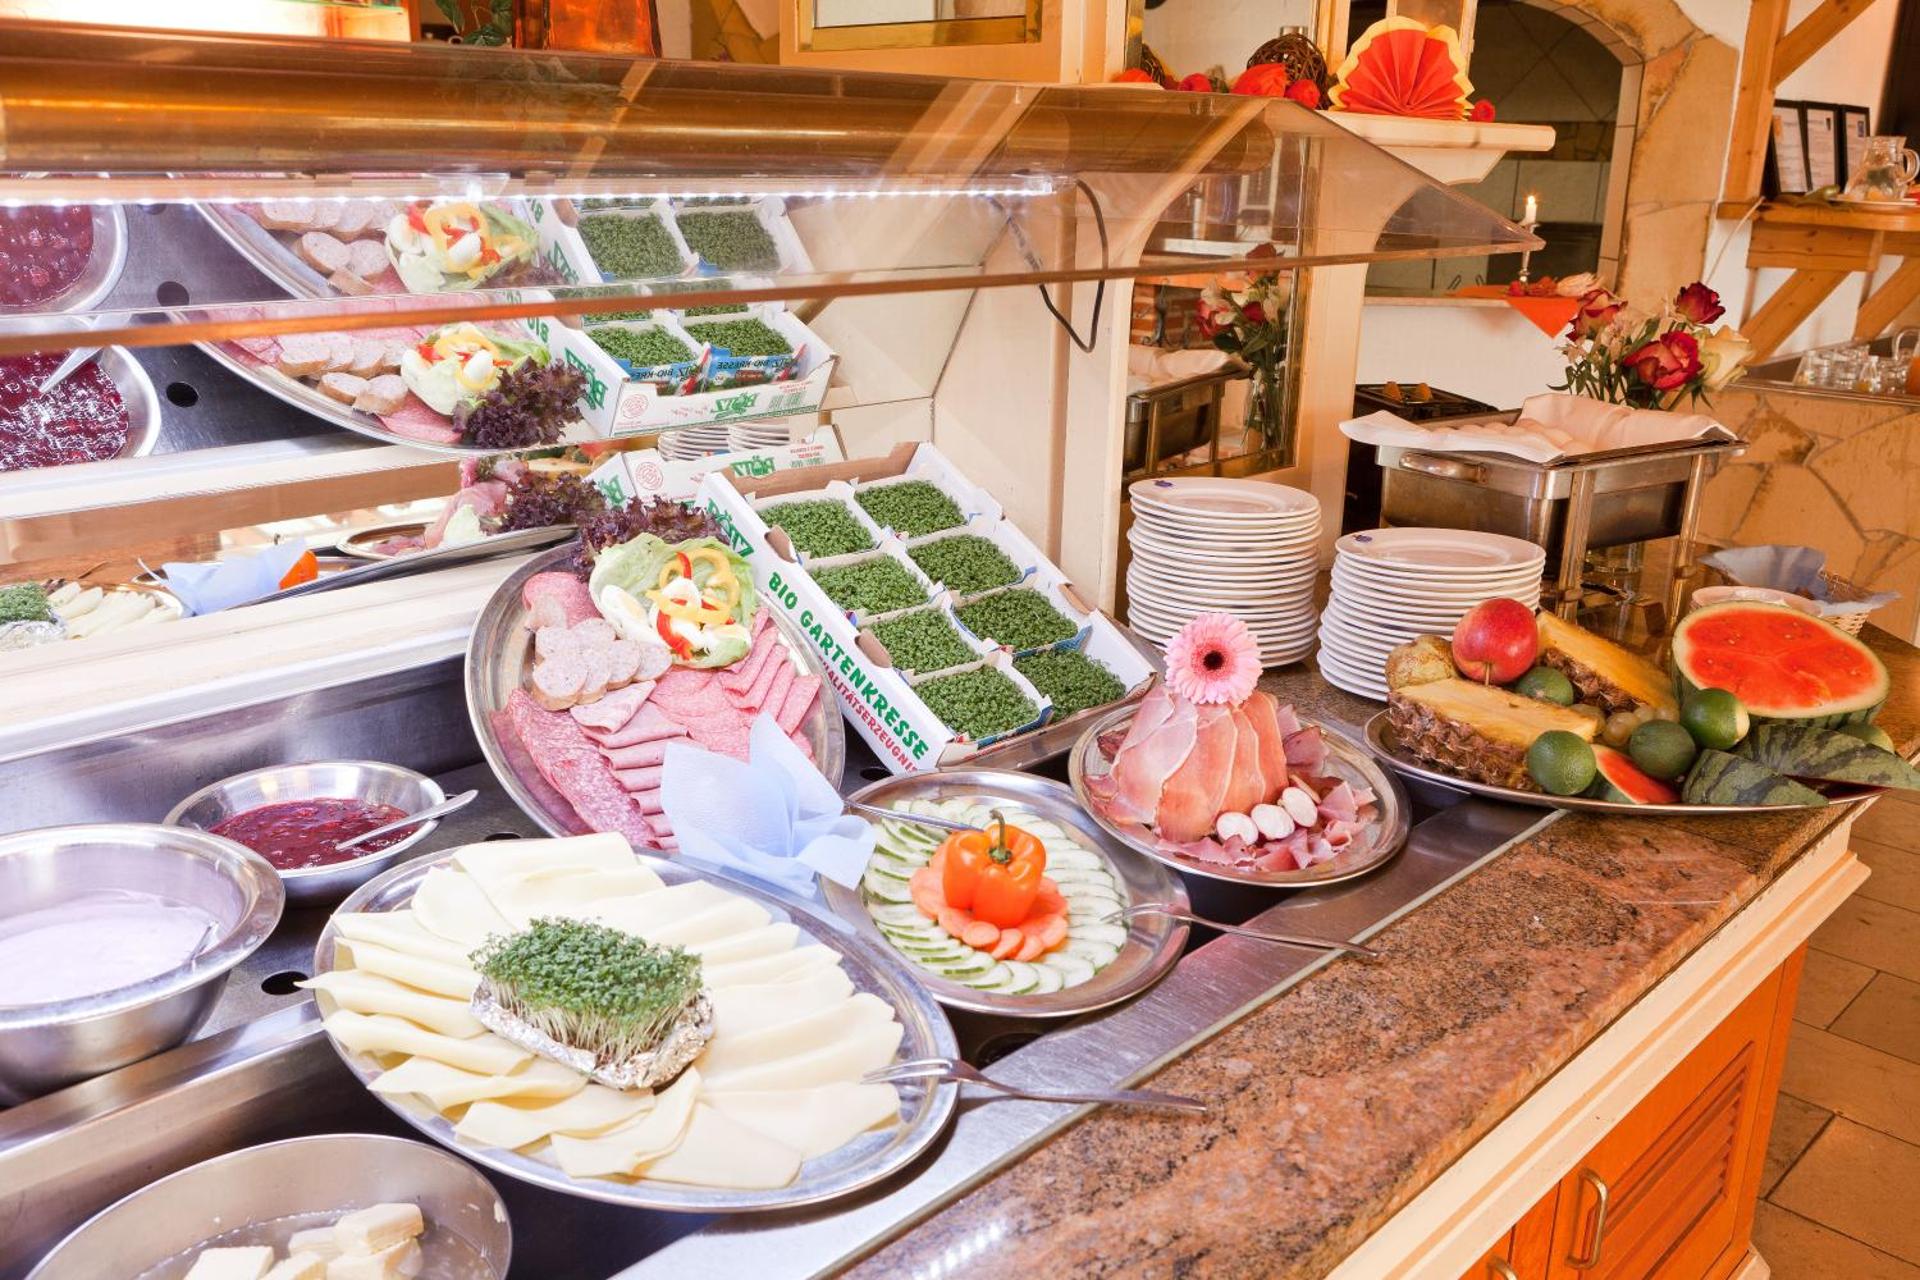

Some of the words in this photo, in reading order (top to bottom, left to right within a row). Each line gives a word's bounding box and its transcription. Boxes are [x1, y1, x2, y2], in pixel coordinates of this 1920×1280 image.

[768, 571, 798, 610] BIO
[799, 609, 929, 761] GARTENKRESSE
[818, 654, 918, 773] ALITÄTSERZEUGNI
